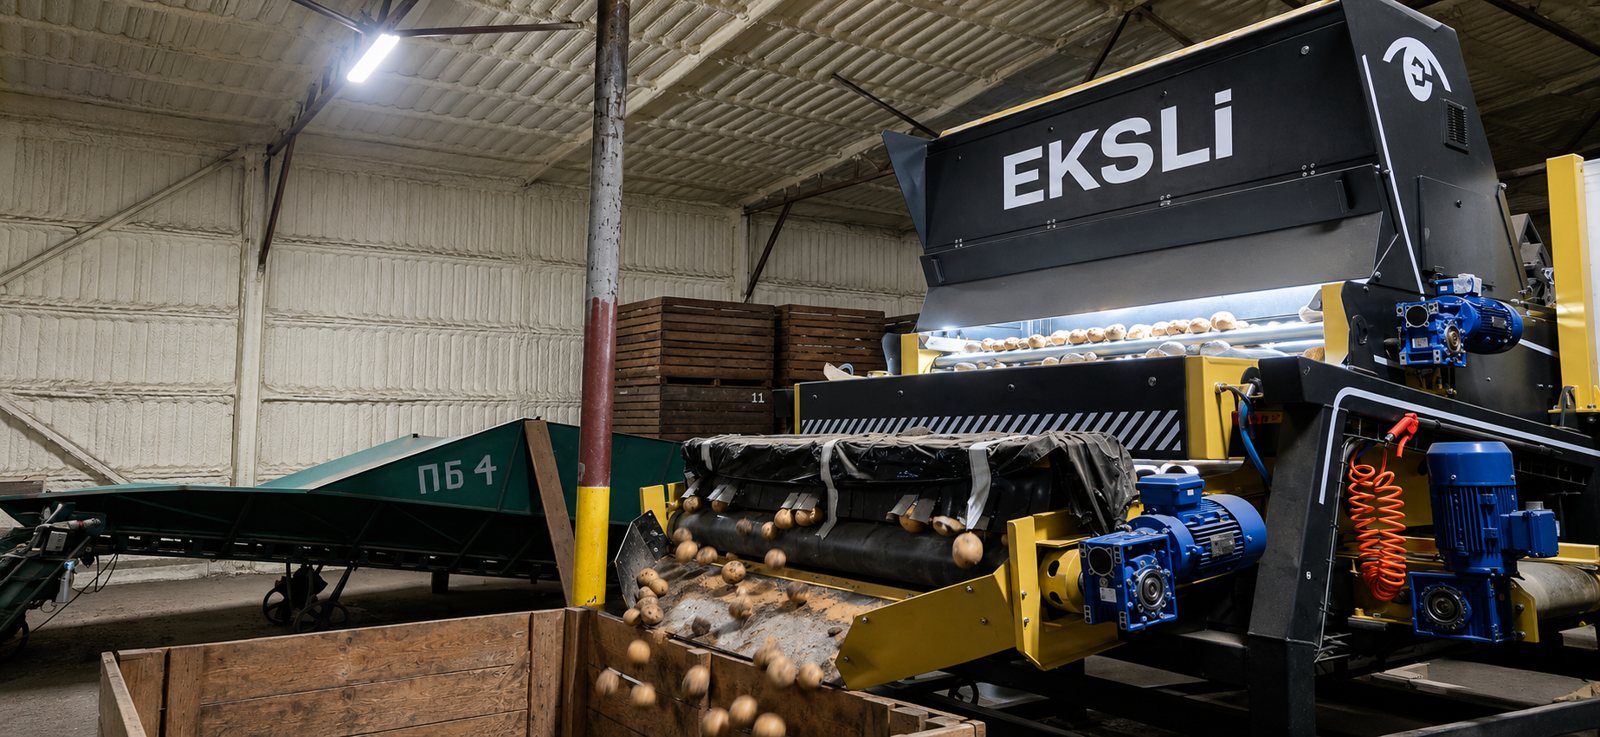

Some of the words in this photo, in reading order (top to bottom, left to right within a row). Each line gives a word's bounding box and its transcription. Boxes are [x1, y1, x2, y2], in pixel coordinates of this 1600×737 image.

[1003, 88, 1233, 210] EKSLi
[751, 392, 765, 403] 11
[418, 460, 464, 494] ПБ
[474, 454, 497, 485] 4
